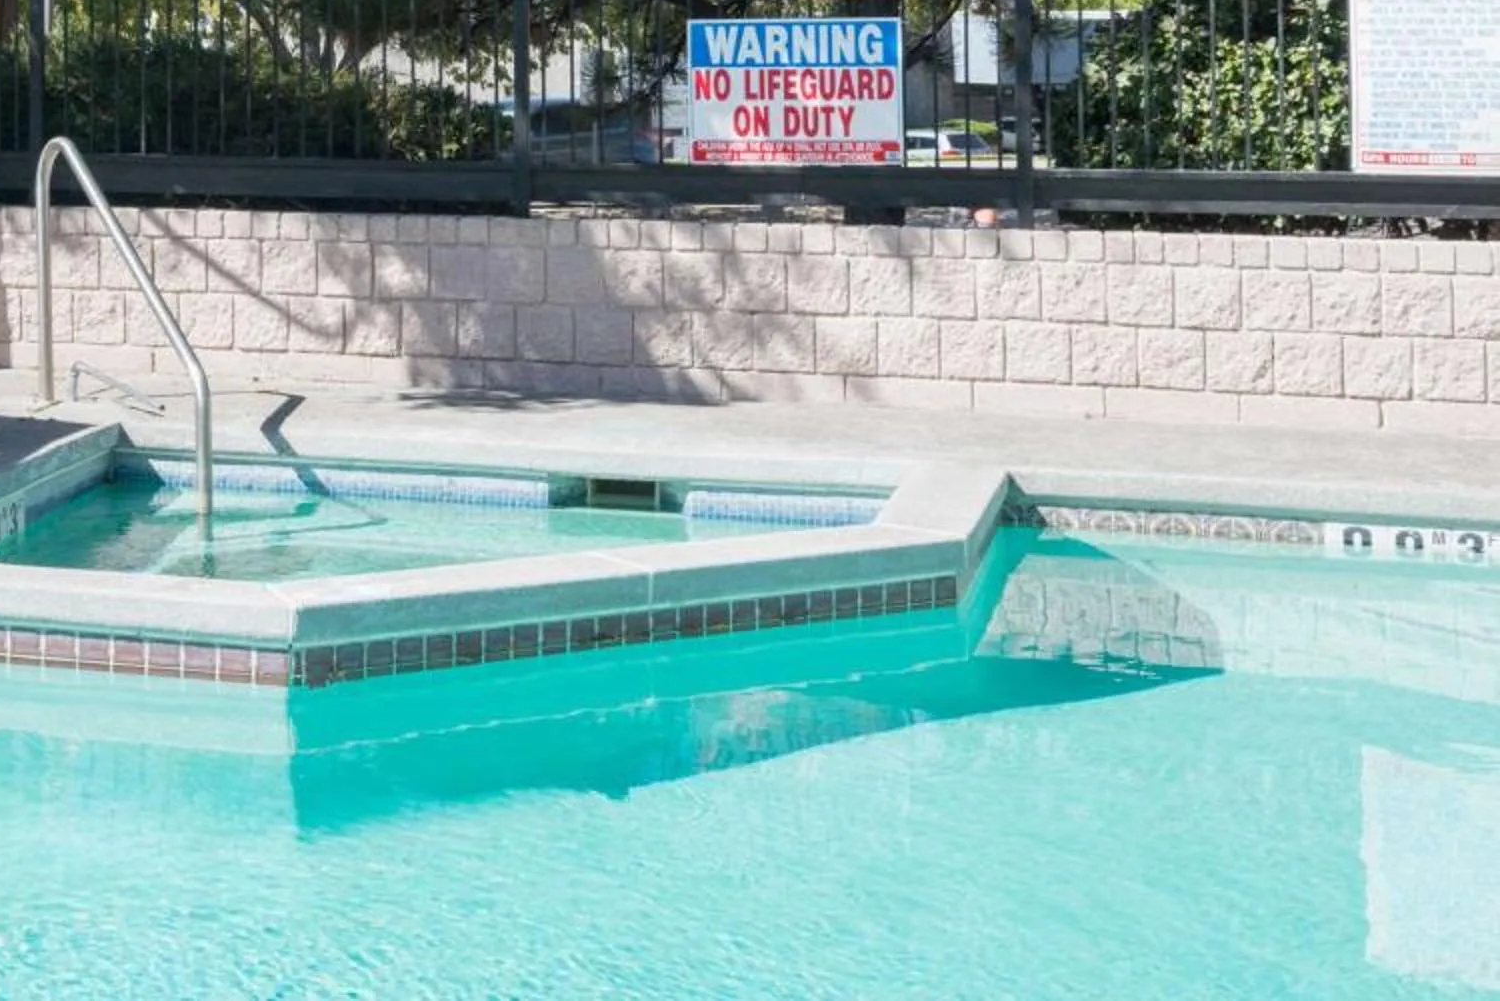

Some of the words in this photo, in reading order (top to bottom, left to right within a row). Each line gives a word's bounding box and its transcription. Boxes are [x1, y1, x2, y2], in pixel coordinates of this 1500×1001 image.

[704, 24, 884, 65] WARNING
[695, 69, 731, 101] NO
[744, 68, 894, 101] LIFEGUARD
[733, 106, 770, 137] ON
[784, 105, 855, 137] DUTY
